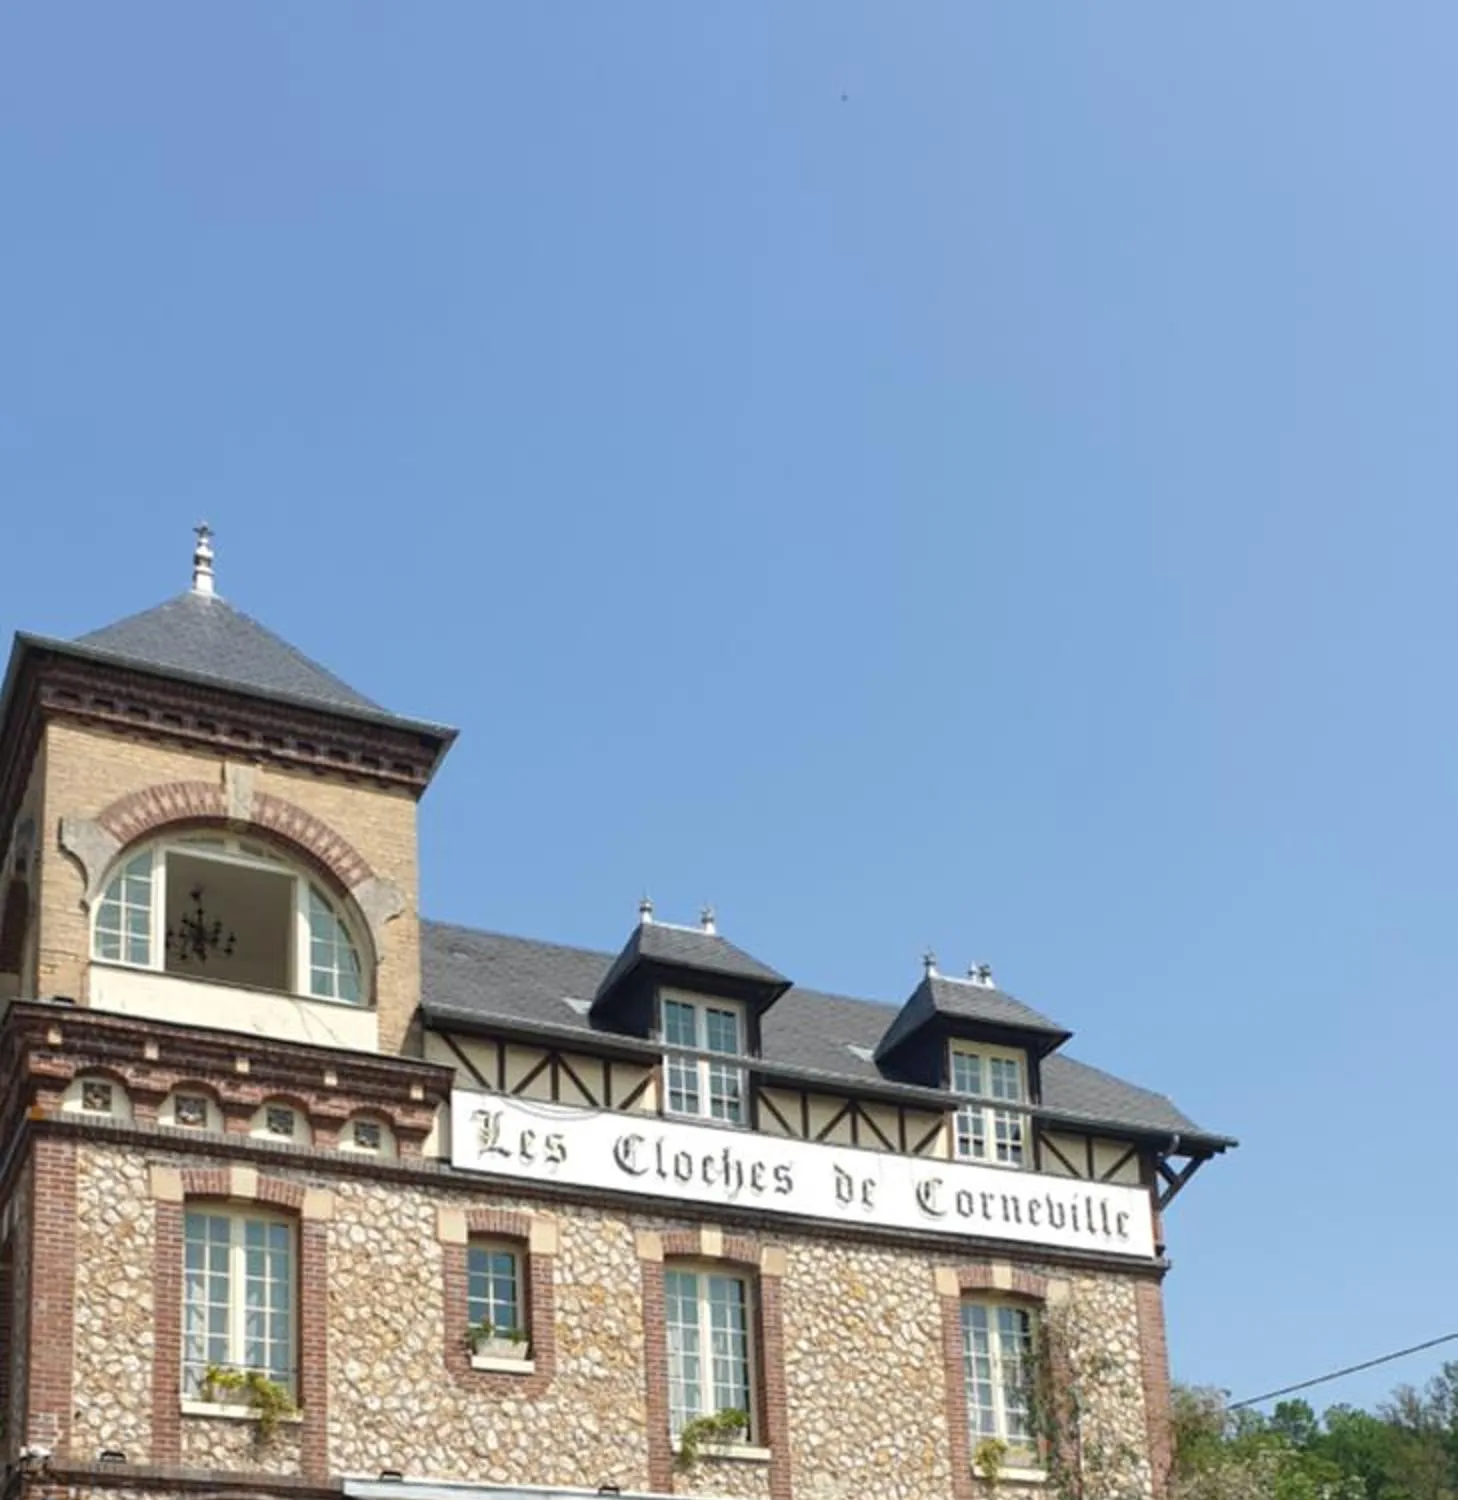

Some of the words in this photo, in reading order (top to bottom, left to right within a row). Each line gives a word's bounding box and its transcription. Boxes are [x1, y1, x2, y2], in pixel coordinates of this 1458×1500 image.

[471, 1108, 568, 1164] Les
[612, 1132, 795, 1198] Cloches
[833, 1162, 876, 1210] de
[916, 1177, 1130, 1239] Corneville
